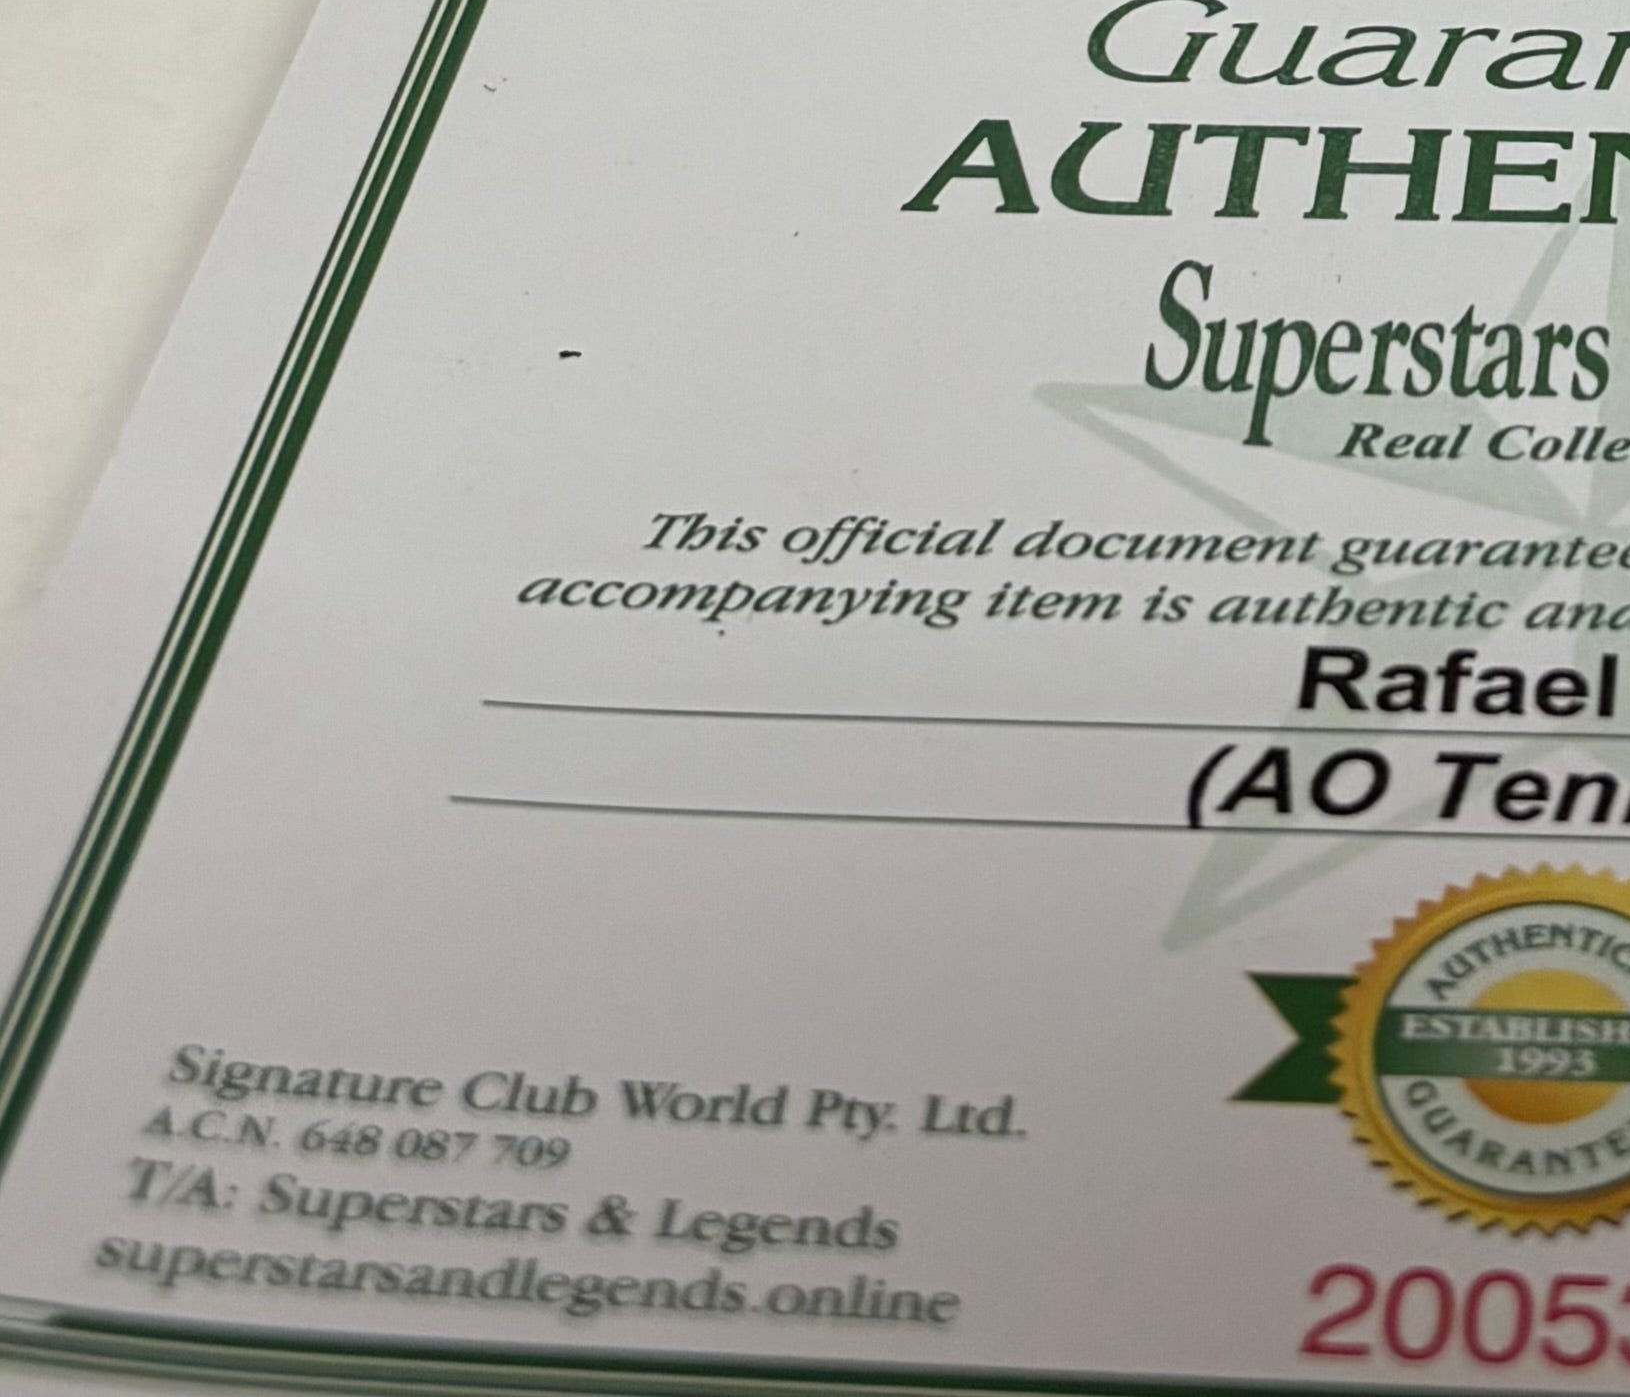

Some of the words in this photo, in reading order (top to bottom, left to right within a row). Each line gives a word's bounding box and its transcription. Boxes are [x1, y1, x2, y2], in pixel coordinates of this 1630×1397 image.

[1142, 258, 1612, 449] Superstars
[1338, 420, 1470, 462] Real
[642, 511, 767, 552] This
[782, 514, 1003, 565] official
[1012, 520, 1322, 564] document
[516, 572, 972, 628] accompanying
[986, 586, 1122, 622] item
[1140, 586, 1190, 624] is
[1209, 585, 1510, 630] authentic
[1298, 646, 1618, 720] Rafael
[1184, 744, 1390, 830] (AO
[168, 1044, 444, 1114] Signature
[462, 1072, 598, 1118] Club
[622, 1080, 786, 1130] World
[806, 1090, 898, 1142] Pty.
[920, 1094, 1030, 1138] Ltd.
[1497, 1046, 1600, 1078] 1993
[142, 1108, 280, 1154] A.C.N.
[298, 1124, 380, 1158] 648
[394, 1128, 476, 1164] 087
[492, 1134, 572, 1170] 709
[126, 1158, 240, 1210] T/A:
[256, 1172, 568, 1236] Superstars
[584, 1194, 634, 1240] &
[654, 1200, 900, 1256] Legends
[94, 1232, 962, 1328] superstarsandlegends.online
